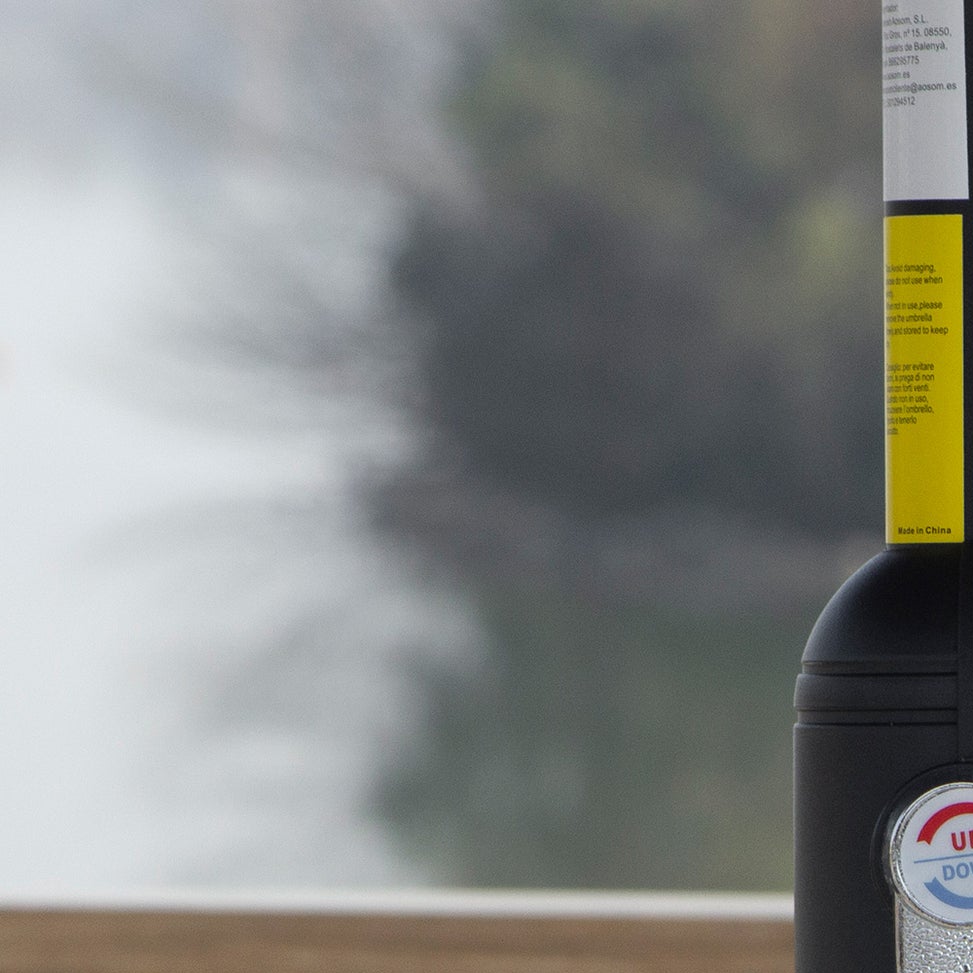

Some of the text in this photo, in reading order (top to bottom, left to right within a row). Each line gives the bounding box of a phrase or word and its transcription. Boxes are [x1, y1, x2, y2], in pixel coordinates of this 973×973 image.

[913, 14, 928, 24] S.L.
[930, 326, 949, 335] keep
[898, 526, 952, 535] Made in China
